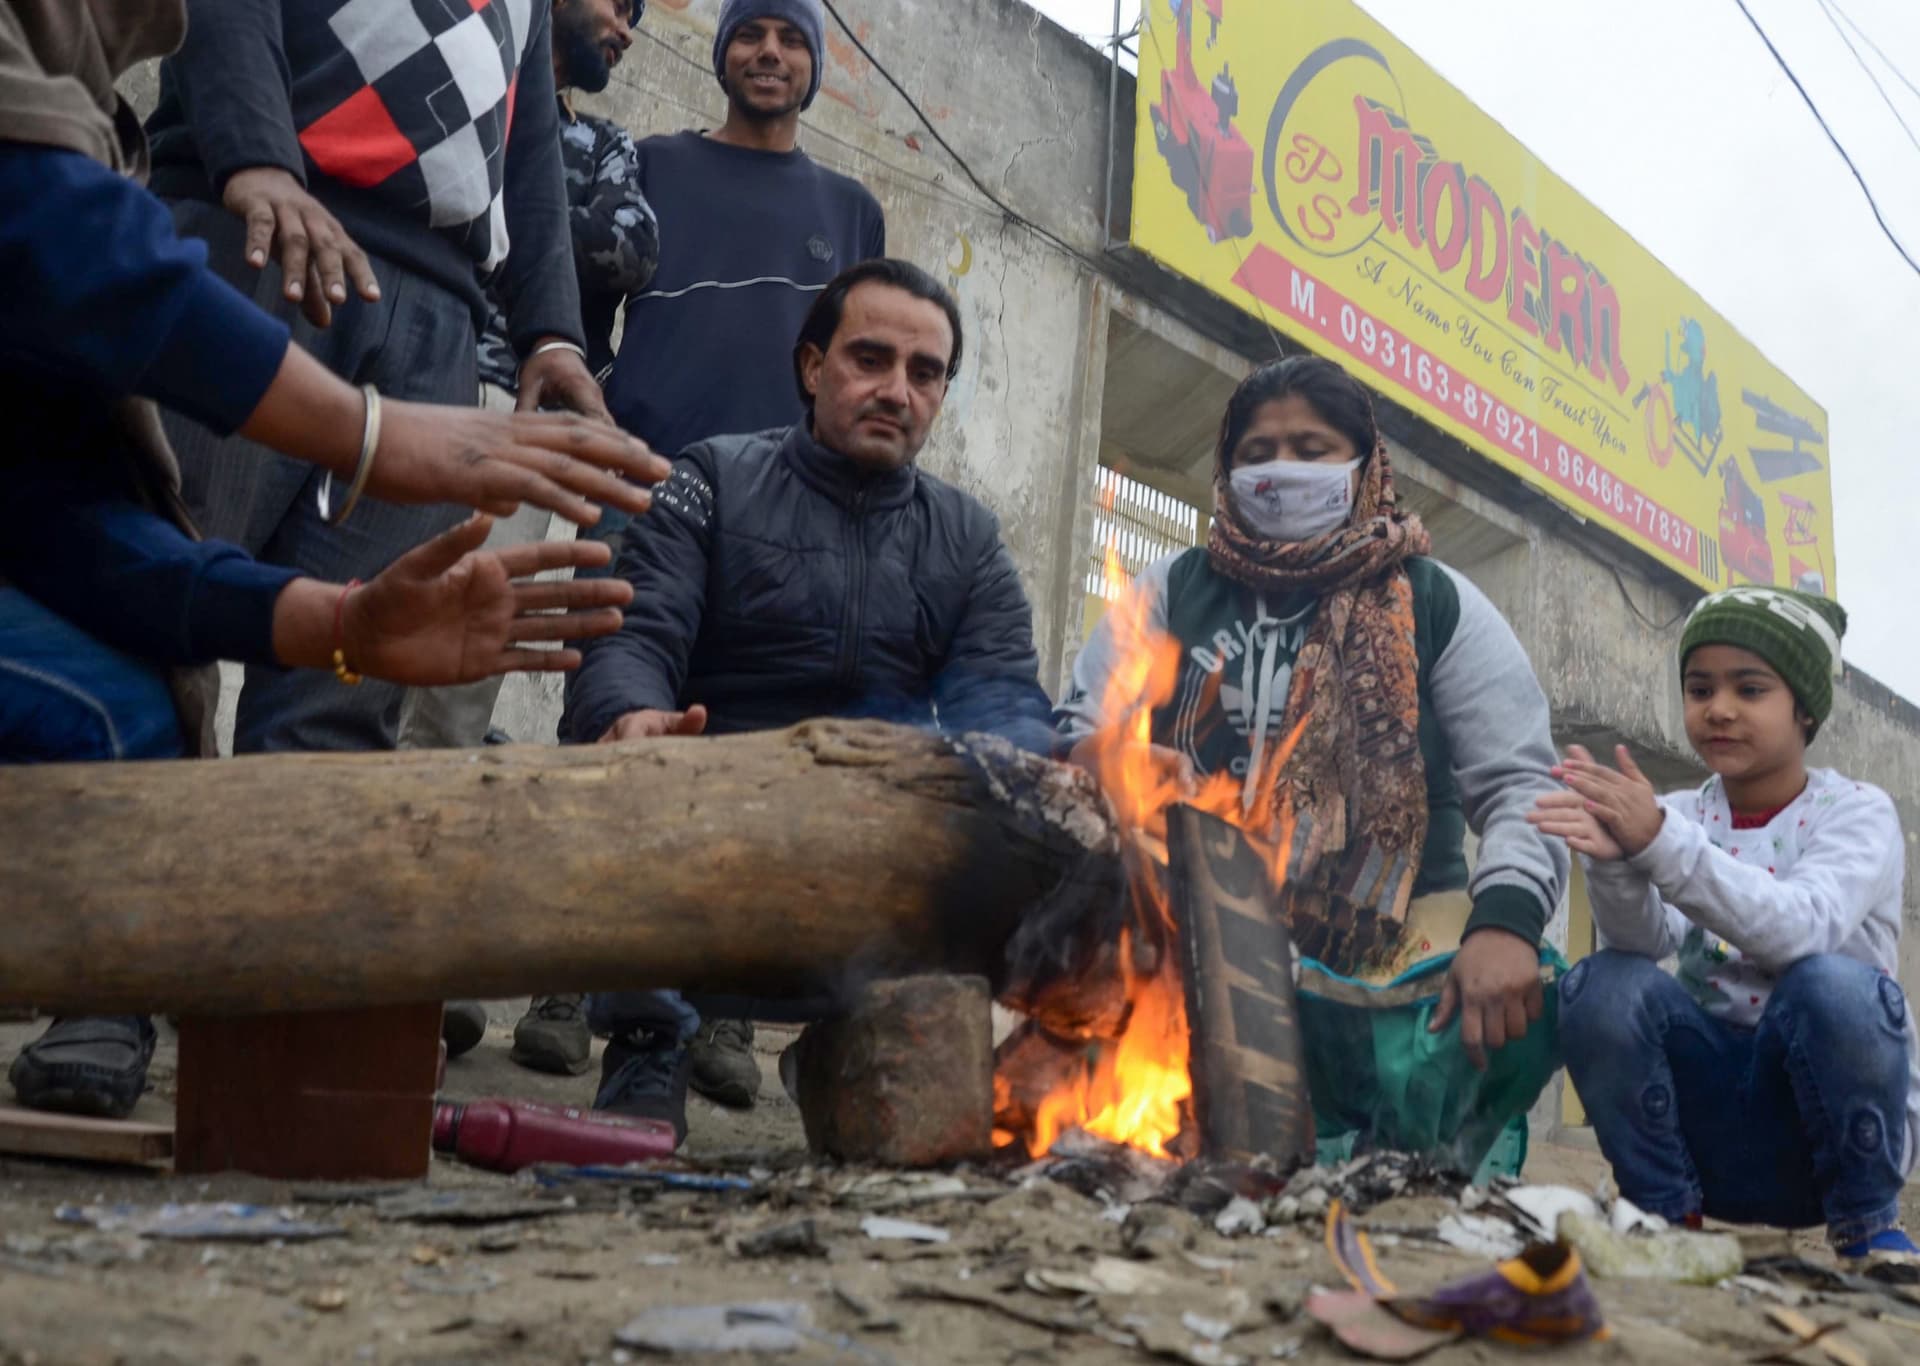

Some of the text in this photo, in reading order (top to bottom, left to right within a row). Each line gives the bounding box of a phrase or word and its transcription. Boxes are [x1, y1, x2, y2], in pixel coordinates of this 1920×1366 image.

[1290, 268, 1328, 327] M.
[1348, 94, 1631, 398] MODERN
[1356, 256, 1627, 454] A Name You Can Trust Upon
